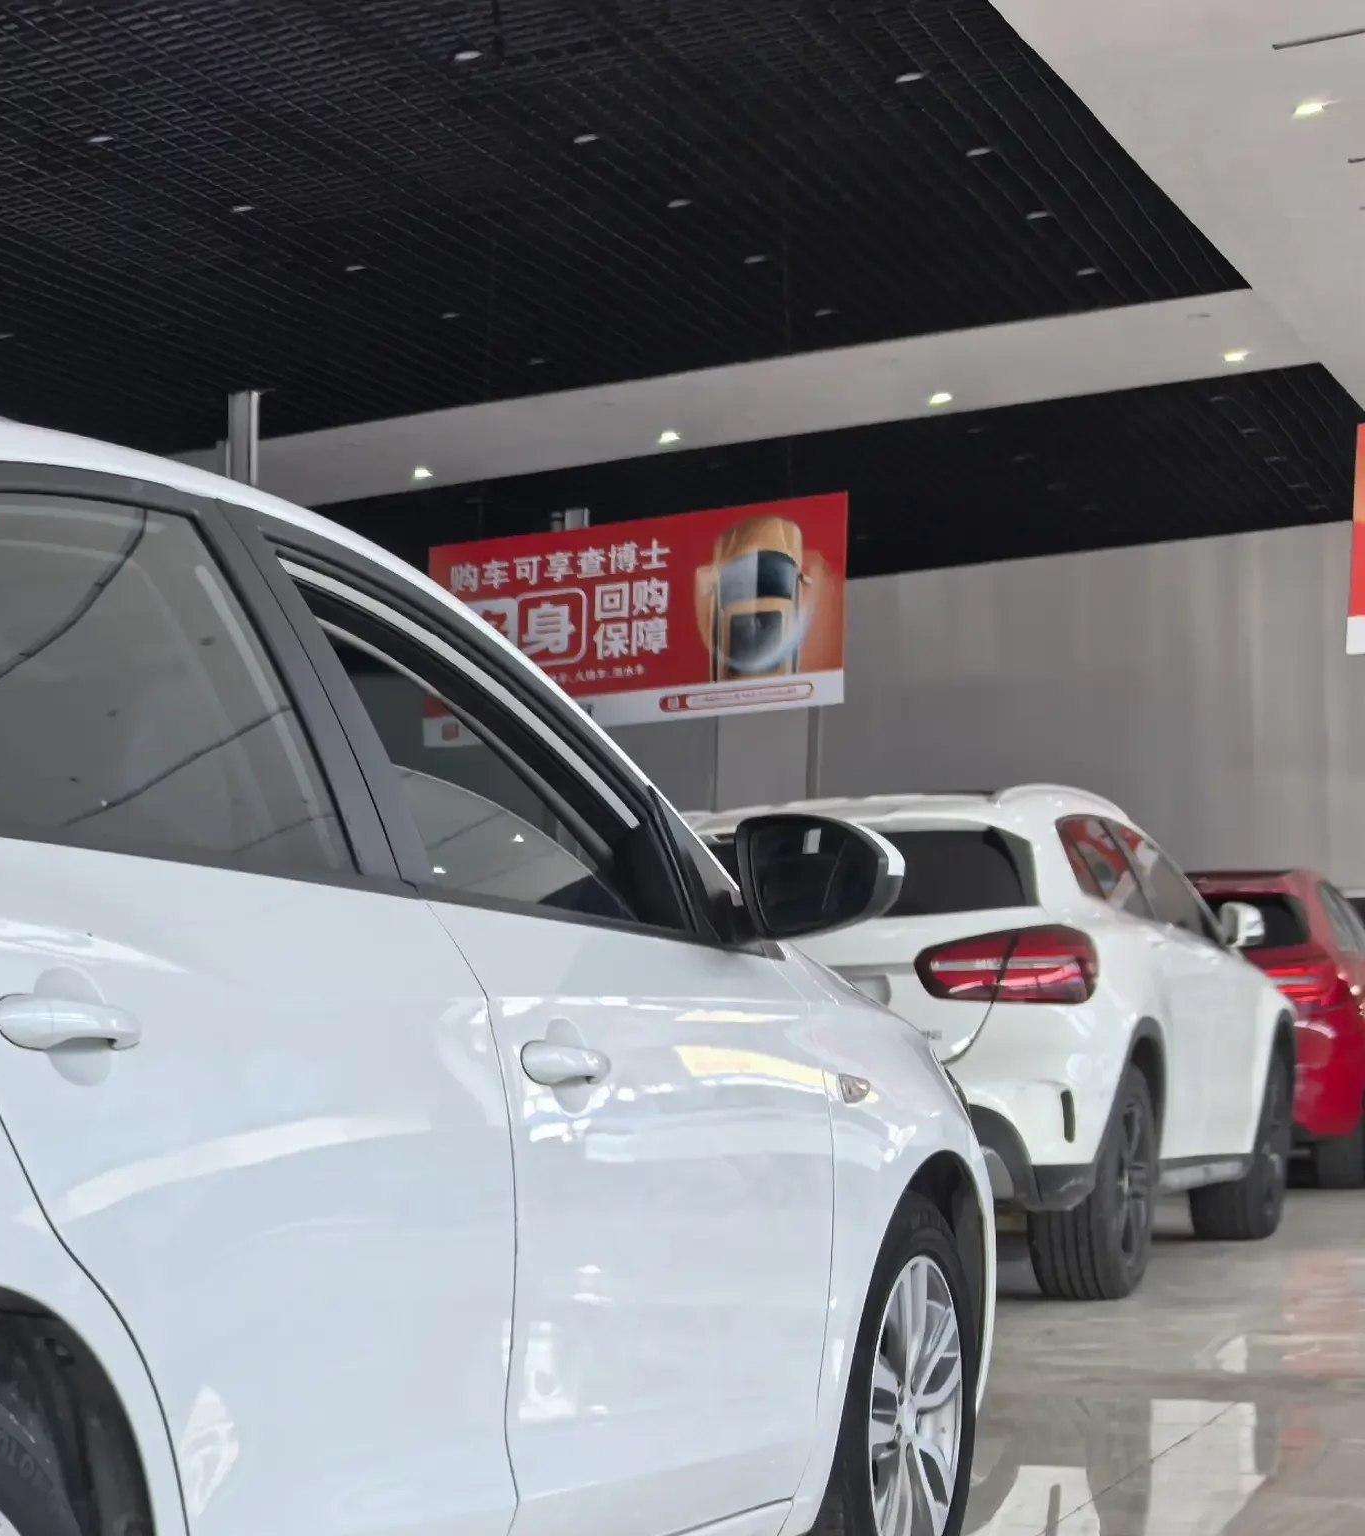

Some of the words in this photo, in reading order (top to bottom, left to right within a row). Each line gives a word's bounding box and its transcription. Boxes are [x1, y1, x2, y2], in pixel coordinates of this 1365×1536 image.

[450, 538, 671, 593] 购车可享查博士
[594, 577, 670, 621] 回购
[593, 618, 670, 661] 保障
